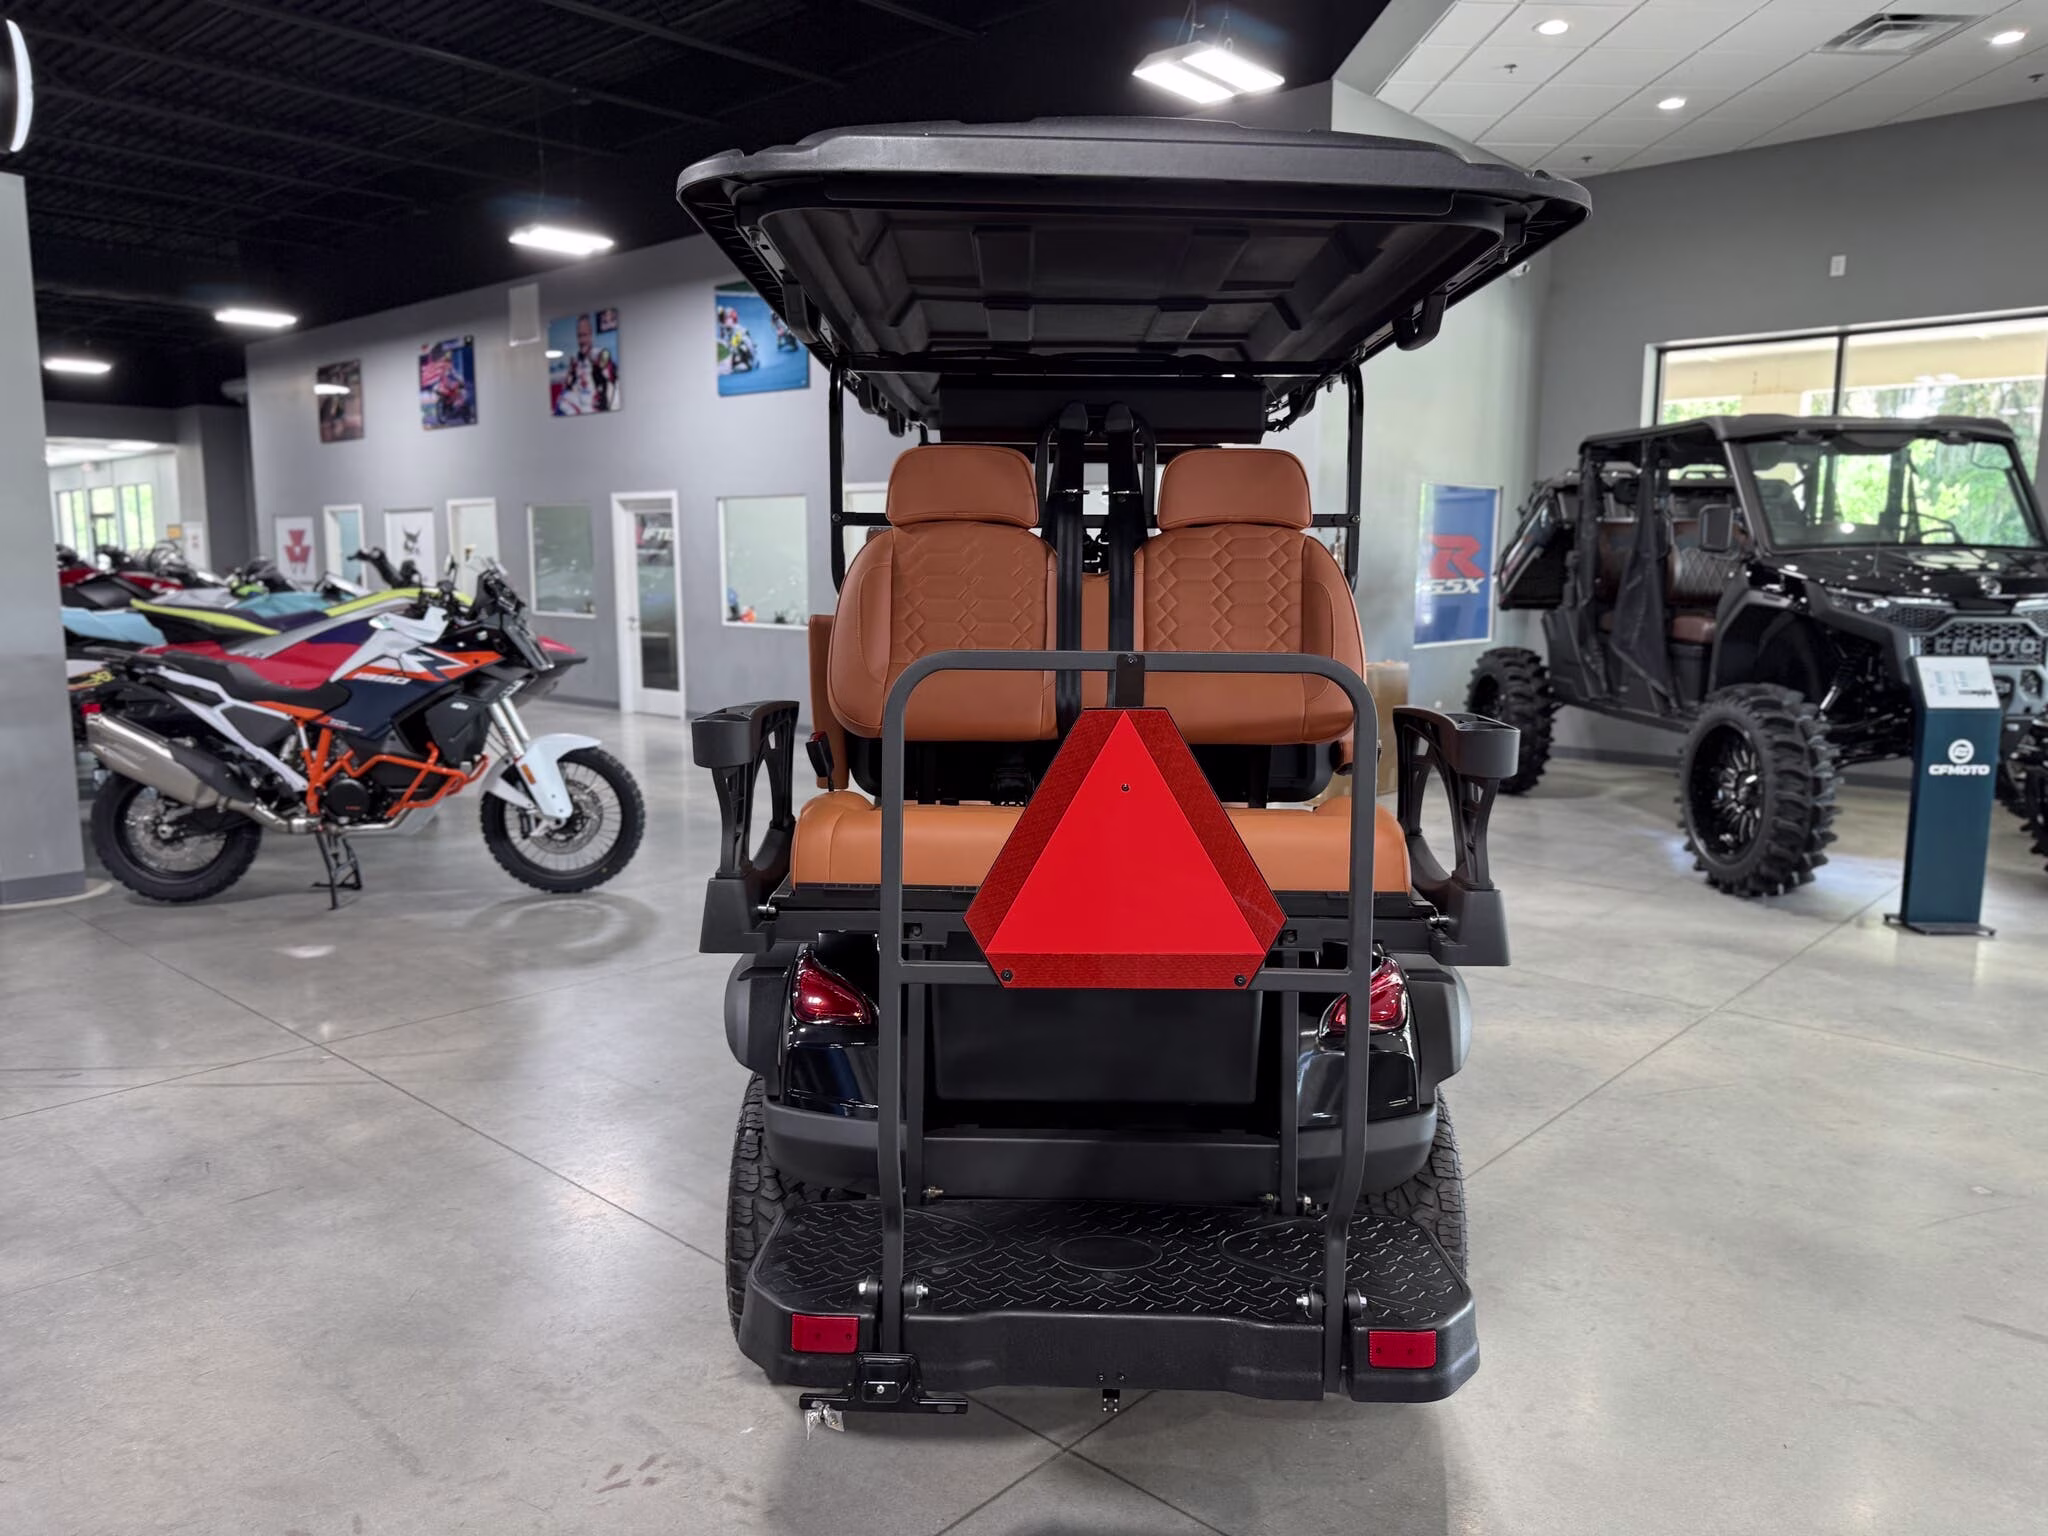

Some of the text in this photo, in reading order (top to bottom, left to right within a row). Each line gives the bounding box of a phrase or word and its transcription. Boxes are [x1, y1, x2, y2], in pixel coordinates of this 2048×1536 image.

[1428, 533, 1485, 579] R
[1934, 638, 2036, 654] CFMOTO
[1928, 764, 1991, 776] CFMOTO
